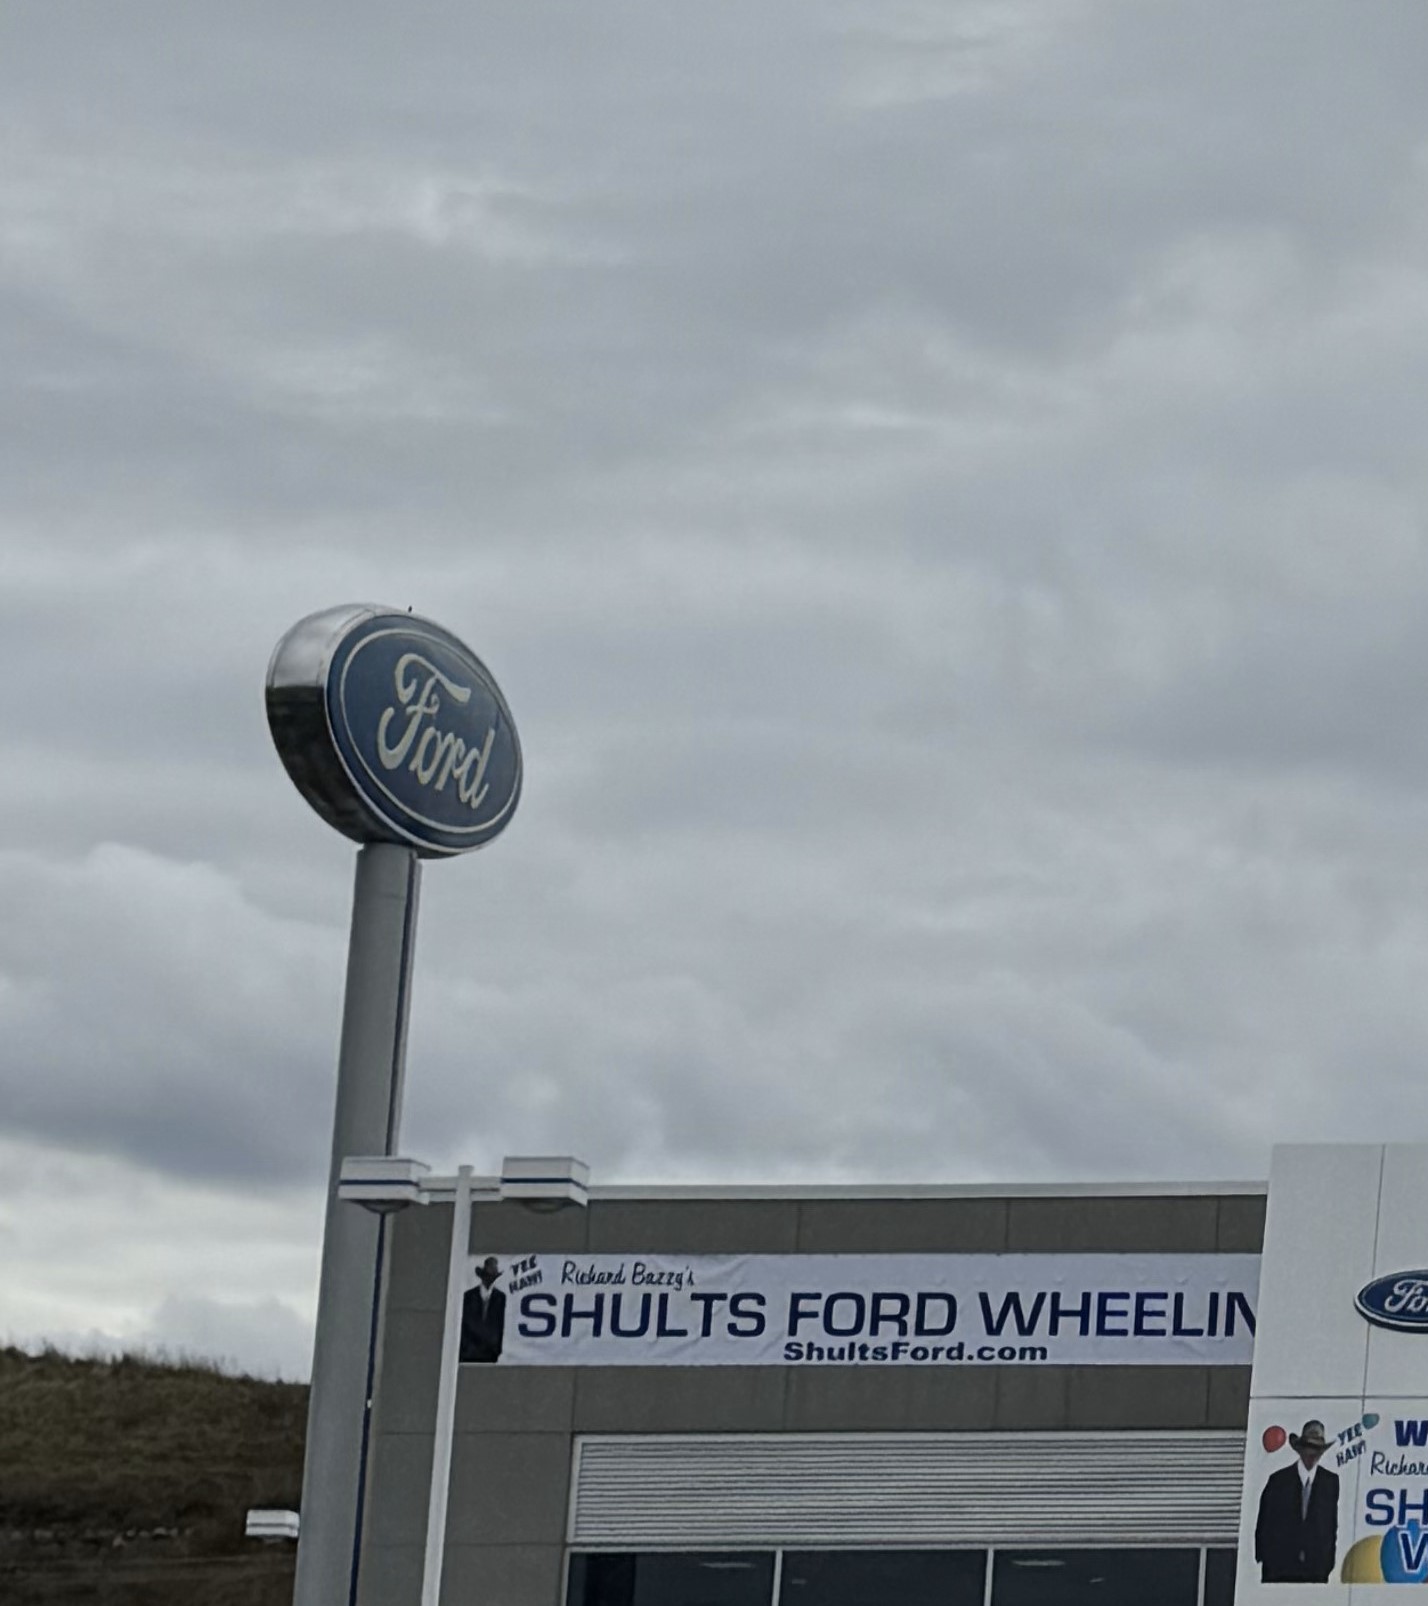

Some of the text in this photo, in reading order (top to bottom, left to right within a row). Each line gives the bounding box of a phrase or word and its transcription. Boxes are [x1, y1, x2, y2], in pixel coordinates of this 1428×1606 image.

[377, 653, 495, 809] Ford
[561, 1260, 625, 1285] Richard
[517, 1292, 1257, 1339] SHULTS FORD WHEELIN
[783, 1340, 1048, 1362] ShultsFord.com
